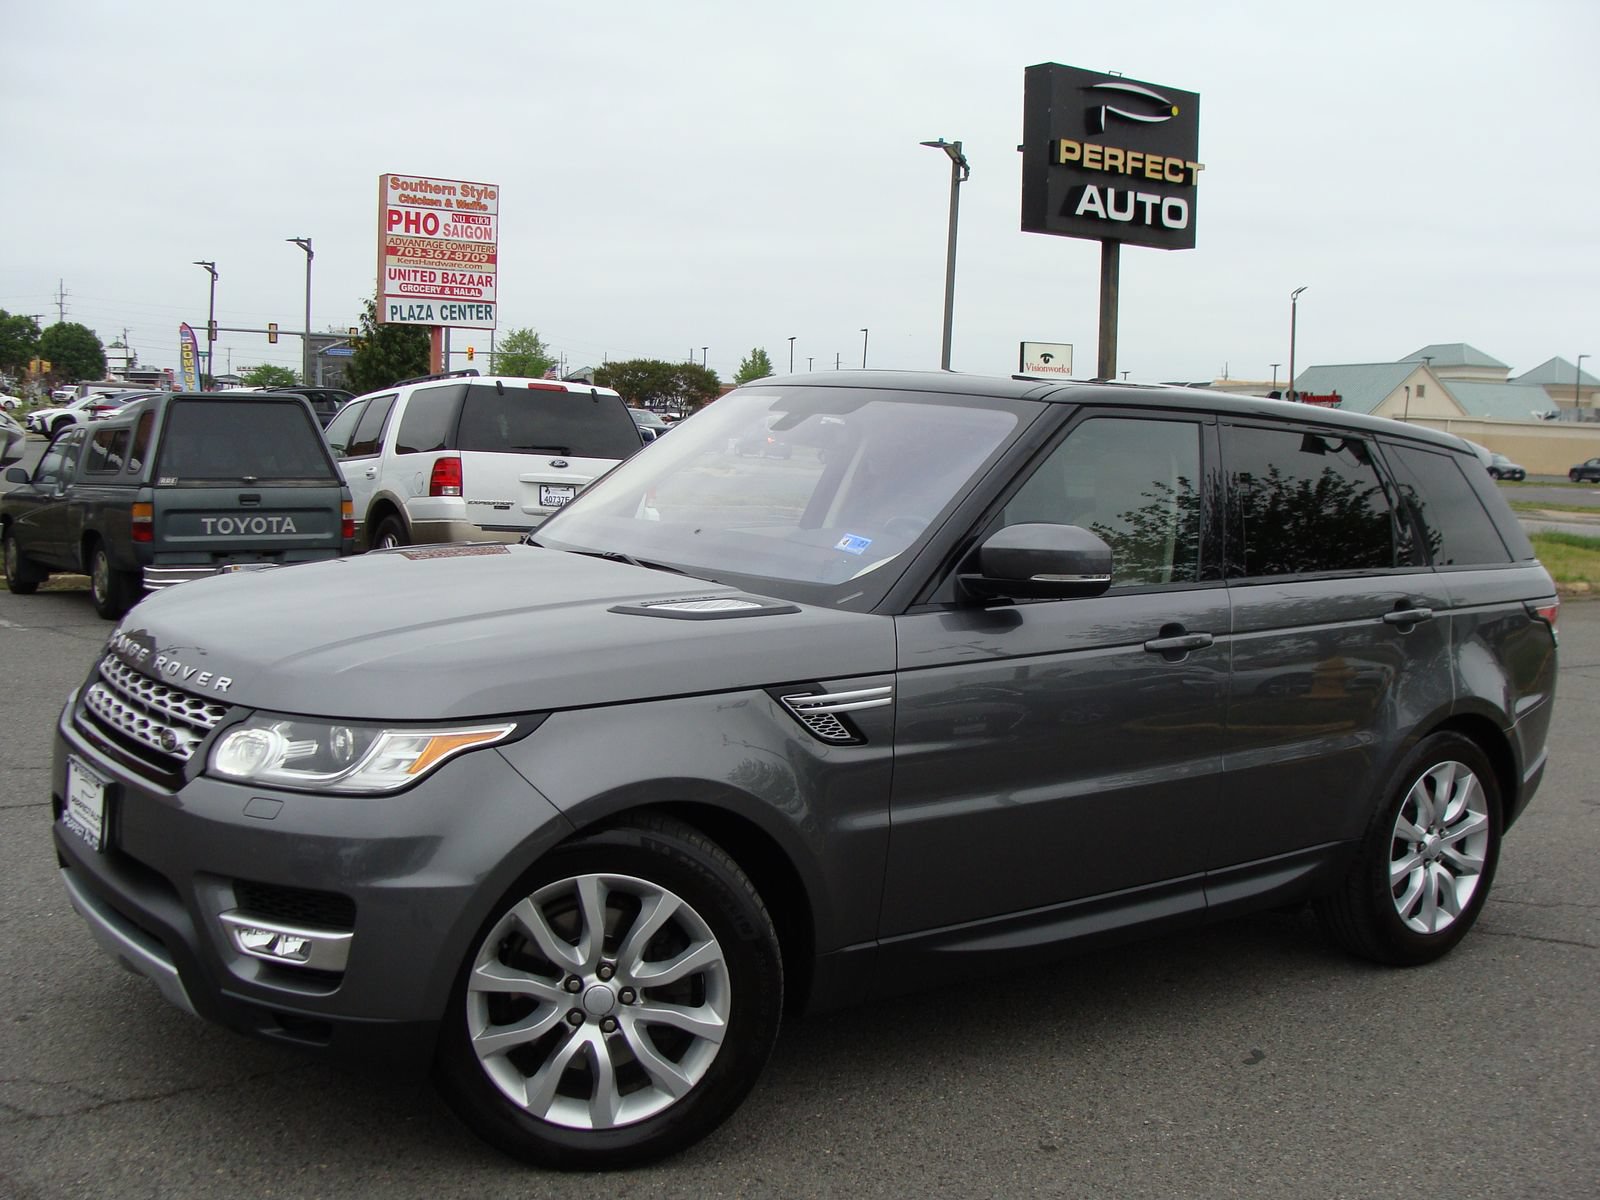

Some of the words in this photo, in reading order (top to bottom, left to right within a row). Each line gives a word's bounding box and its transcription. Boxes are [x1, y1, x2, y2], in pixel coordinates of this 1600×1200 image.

[1059, 138, 1205, 186] PERFECT
[390, 176, 457, 196] Southern
[460, 184, 497, 201] Style
[398, 193, 442, 207] Chicken
[444, 198, 453, 208] &
[456, 199, 488, 211] Waffle
[1075, 184, 1189, 230] AUTO
[387, 209, 440, 236] PHO
[443, 223, 492, 240] SAIGON
[388, 237, 444, 250] ADVANTAGE
[445, 242, 495, 253] COMPUTERS
[396, 246, 488, 262] 703-367-8709
[397, 257, 483, 270] KensHardware.com
[388, 268, 437, 283] UNITED
[441, 272, 493, 287] BAZAAR
[401, 284, 442, 294] GROCERY
[453, 288, 480, 297] HALAL
[390, 304, 434, 321] PLAZA
[440, 304, 493, 321] CENTER
[1025, 363, 1070, 374] Visionworks
[201, 517, 297, 534] TOYOTA
[153, 656, 232, 692] ROVER
